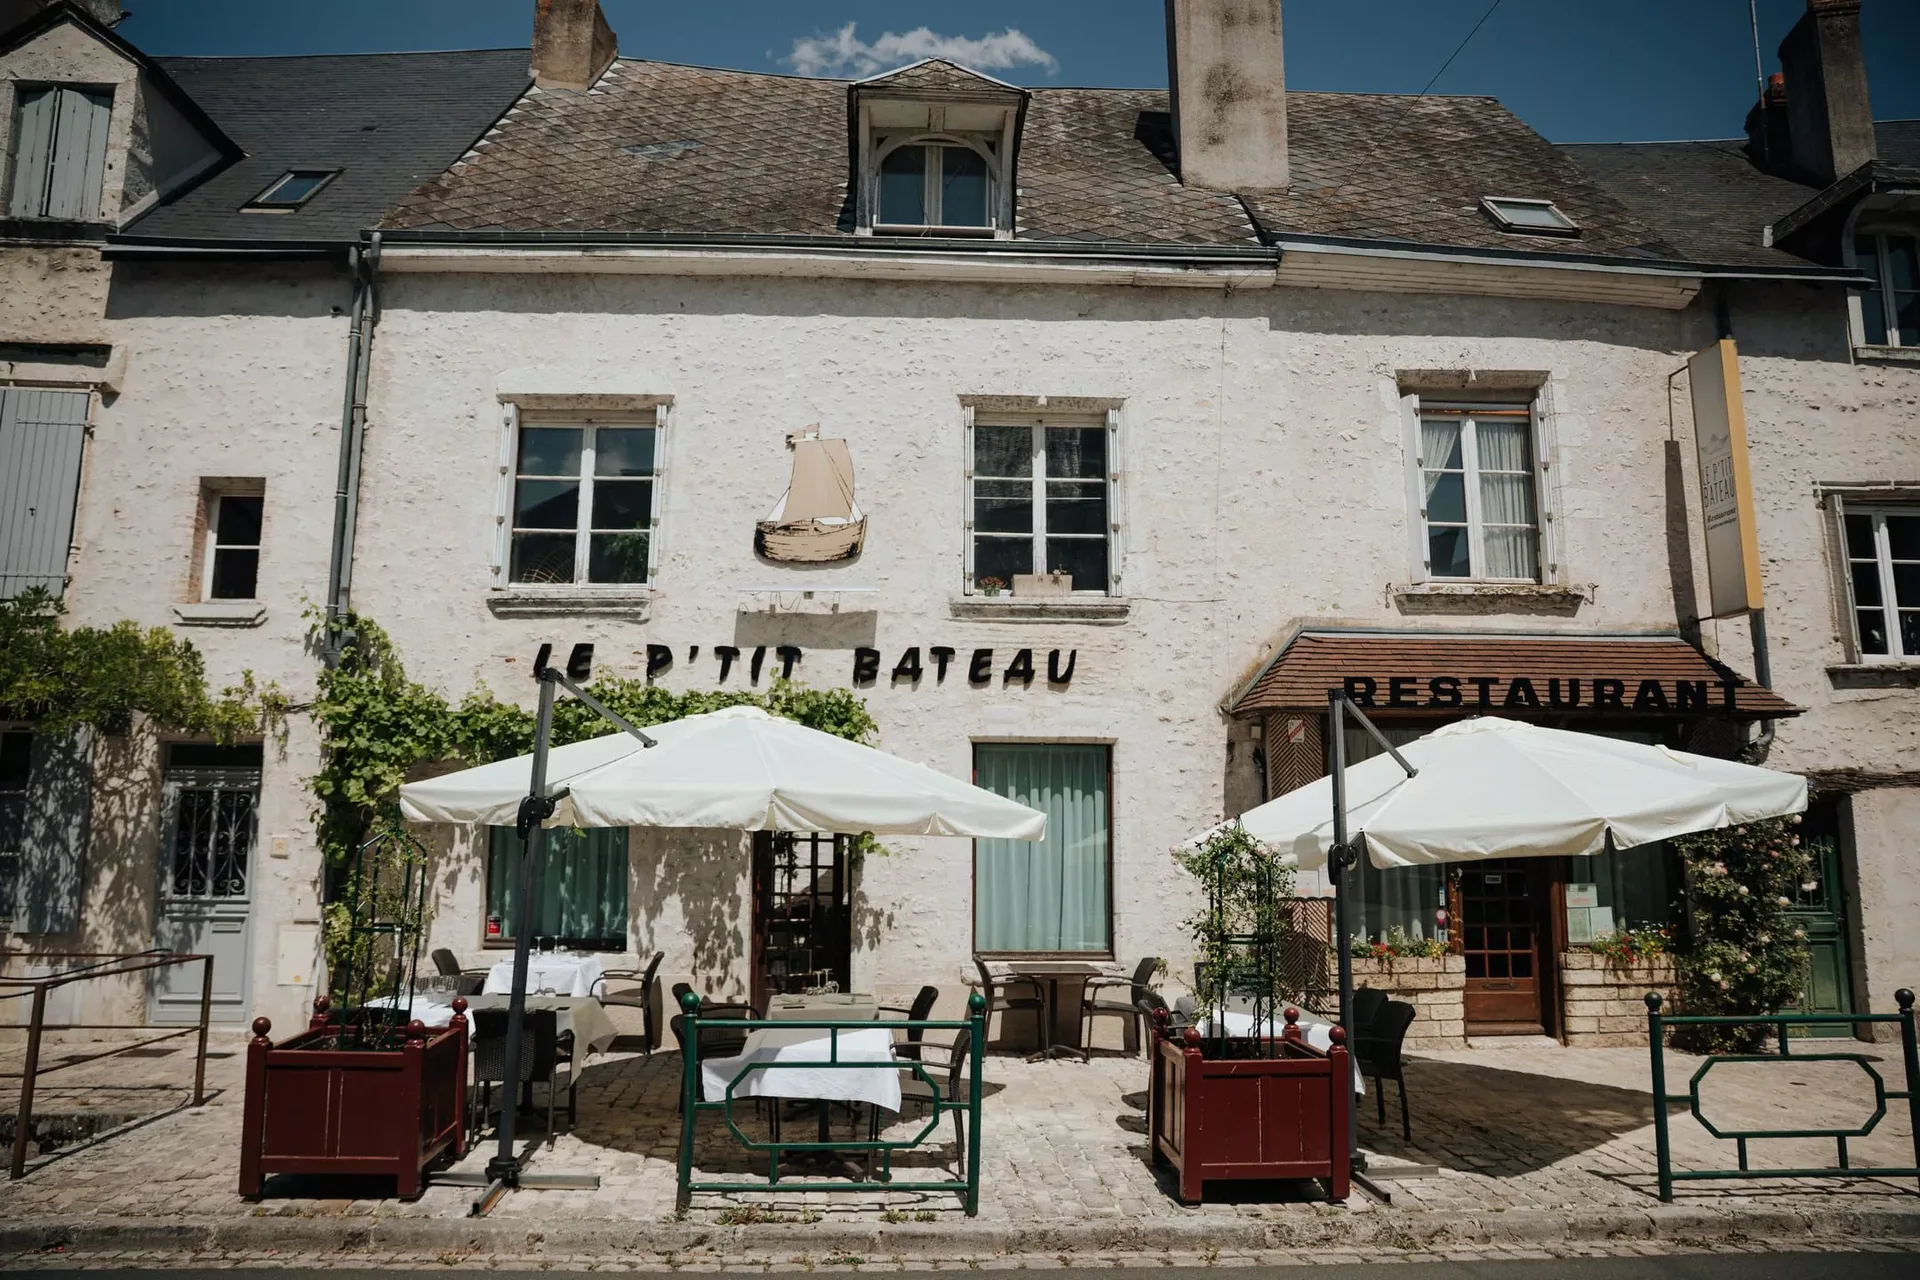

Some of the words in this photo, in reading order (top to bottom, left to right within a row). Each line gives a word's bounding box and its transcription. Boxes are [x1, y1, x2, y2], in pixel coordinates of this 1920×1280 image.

[1702, 466, 1710, 485] LE
[1712, 456, 1732, 480] P'TIT
[1703, 475, 1735, 508] BATEAU
[647, 644, 802, 684] P'TIT
[852, 646, 1077, 684] BATEAU
[1344, 676, 1744, 711] RESTAURANT
